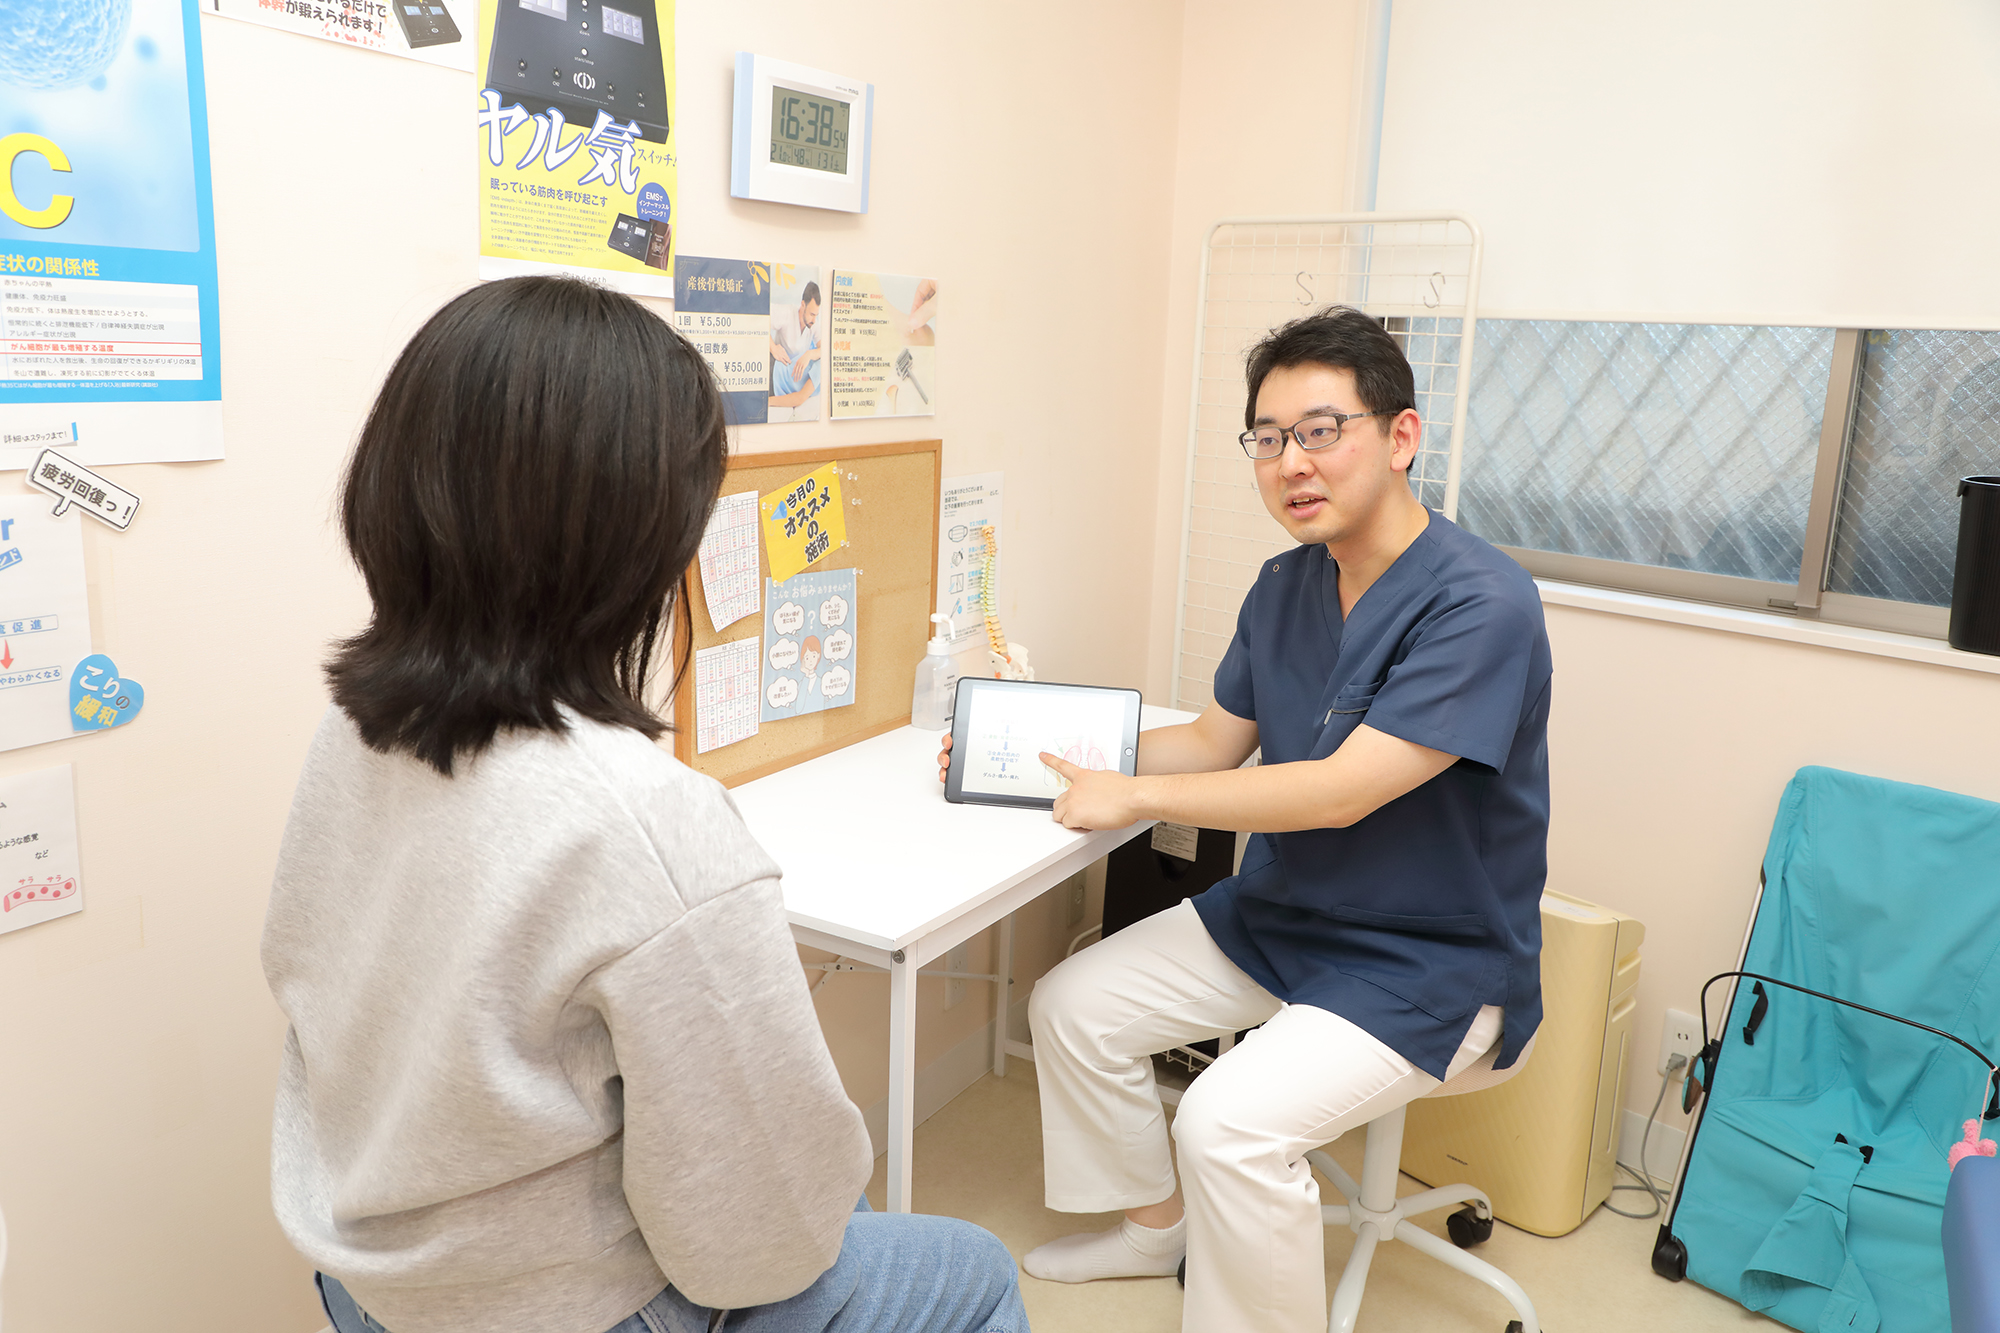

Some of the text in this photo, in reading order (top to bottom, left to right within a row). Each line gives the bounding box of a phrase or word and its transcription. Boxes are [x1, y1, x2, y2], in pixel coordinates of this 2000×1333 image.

[780, 97, 846, 149] 16:38 54
[479, 88, 643, 195] ヤル気
[490, 177, 609, 208] 眠っている筋肉を呼び起こす
[645, 191, 664, 202] EMSで
[639, 200, 669, 210] インナーマッスル
[4, 279, 52, 288] 赤ちゃんの平熱
[687, 275, 744, 293] 産後骨盤矯正
[5, 293, 67, 302] 健康体、免疫力旺盛
[678, 316, 691, 326] 1回
[9, 330, 76, 339] アレルギー症状が出現
[11, 343, 114, 352] がん細胞が最も増殖する温度
[690, 343, 728, 354] な回数券
[40, 462, 131, 520] 疲労回復っ！
[785, 477, 815, 509] 今月の
[784, 486, 831, 539] オススメ
[1, 518, 14, 541] r
[807, 520, 819, 539] の
[804, 530, 830, 563] 施術
[772, 582, 852, 600] こんな お悩み ありませんか？
[79, 665, 130, 709] こりの
[74, 694, 119, 727] 緩和
[35, 849, 49, 859] など
